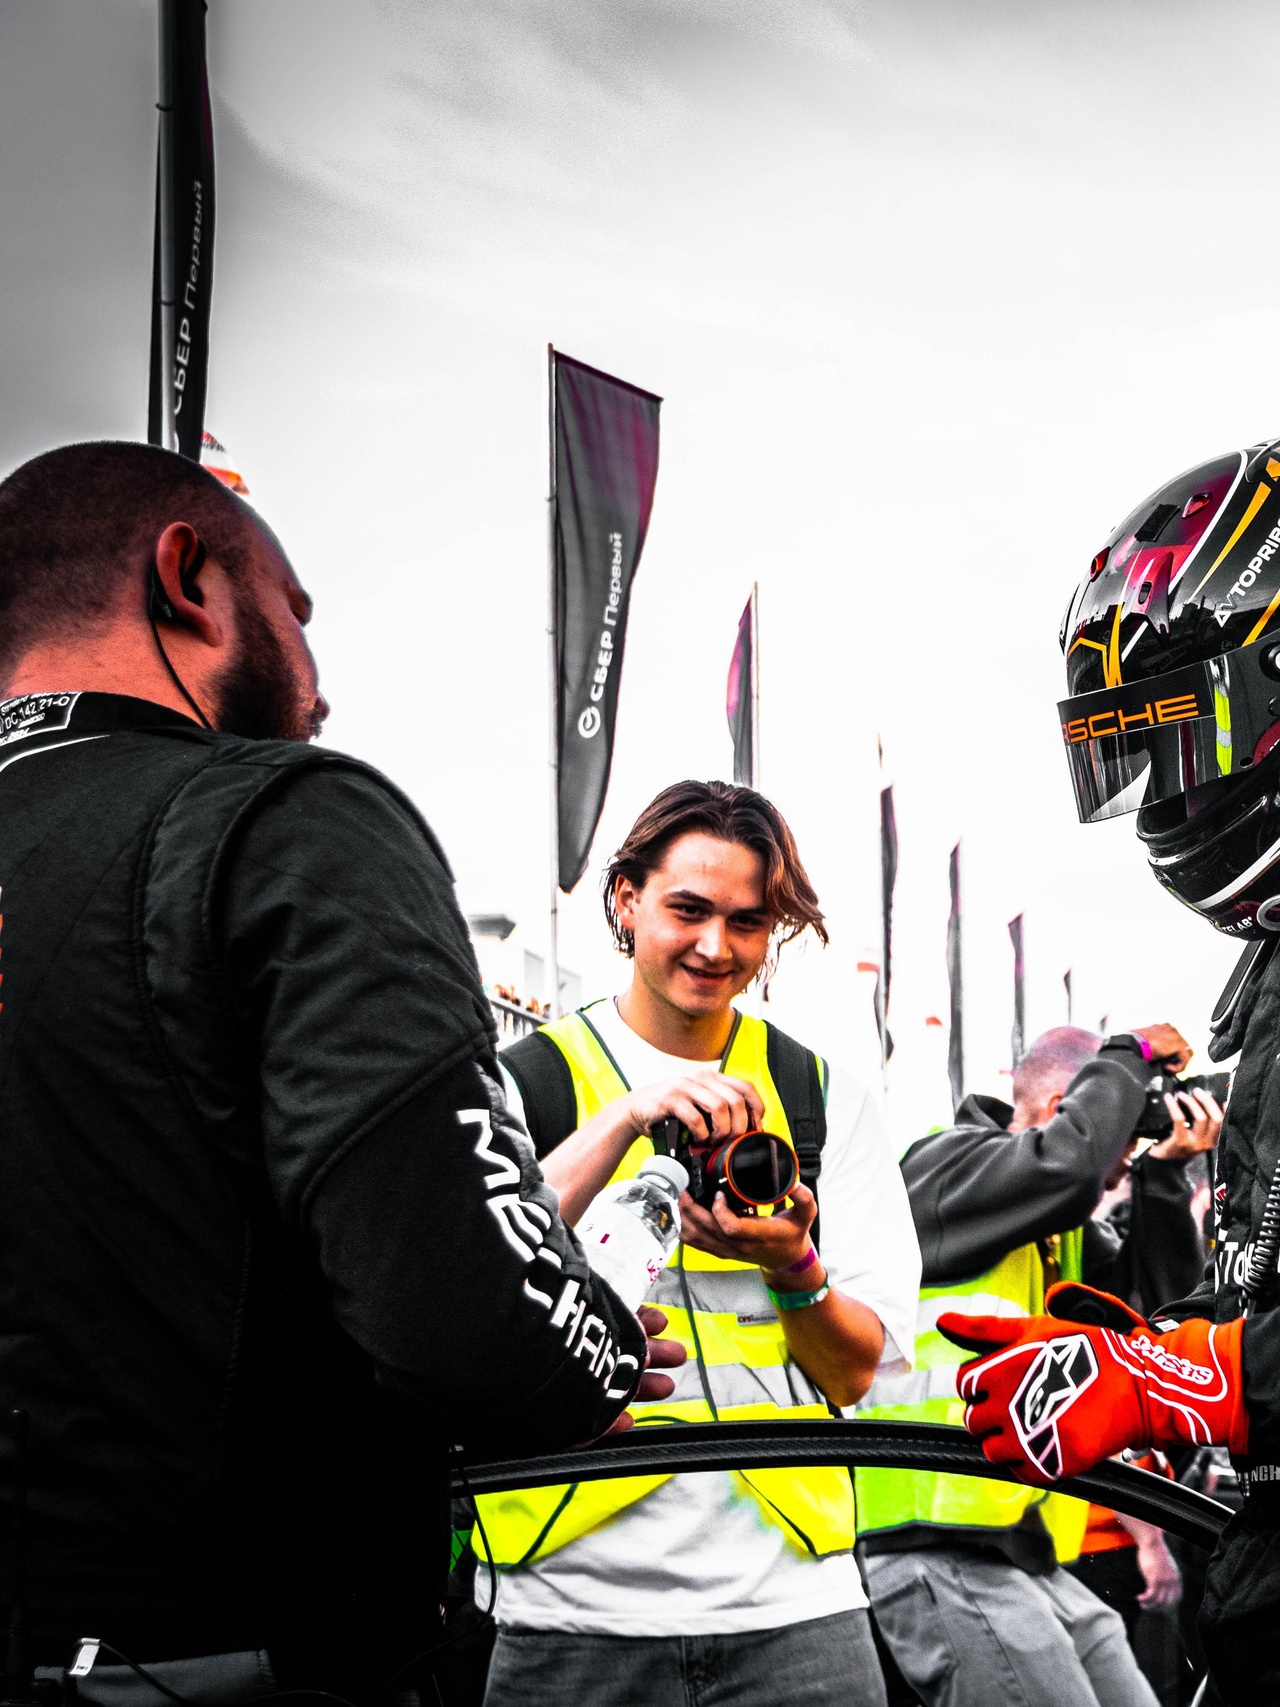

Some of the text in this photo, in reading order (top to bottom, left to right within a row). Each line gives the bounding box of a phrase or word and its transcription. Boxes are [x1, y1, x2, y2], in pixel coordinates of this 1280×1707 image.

[183, 179, 203, 310] Первый
[590, 532, 622, 702] СБЕР Первый
[456, 1108, 639, 1399] MECHANC
